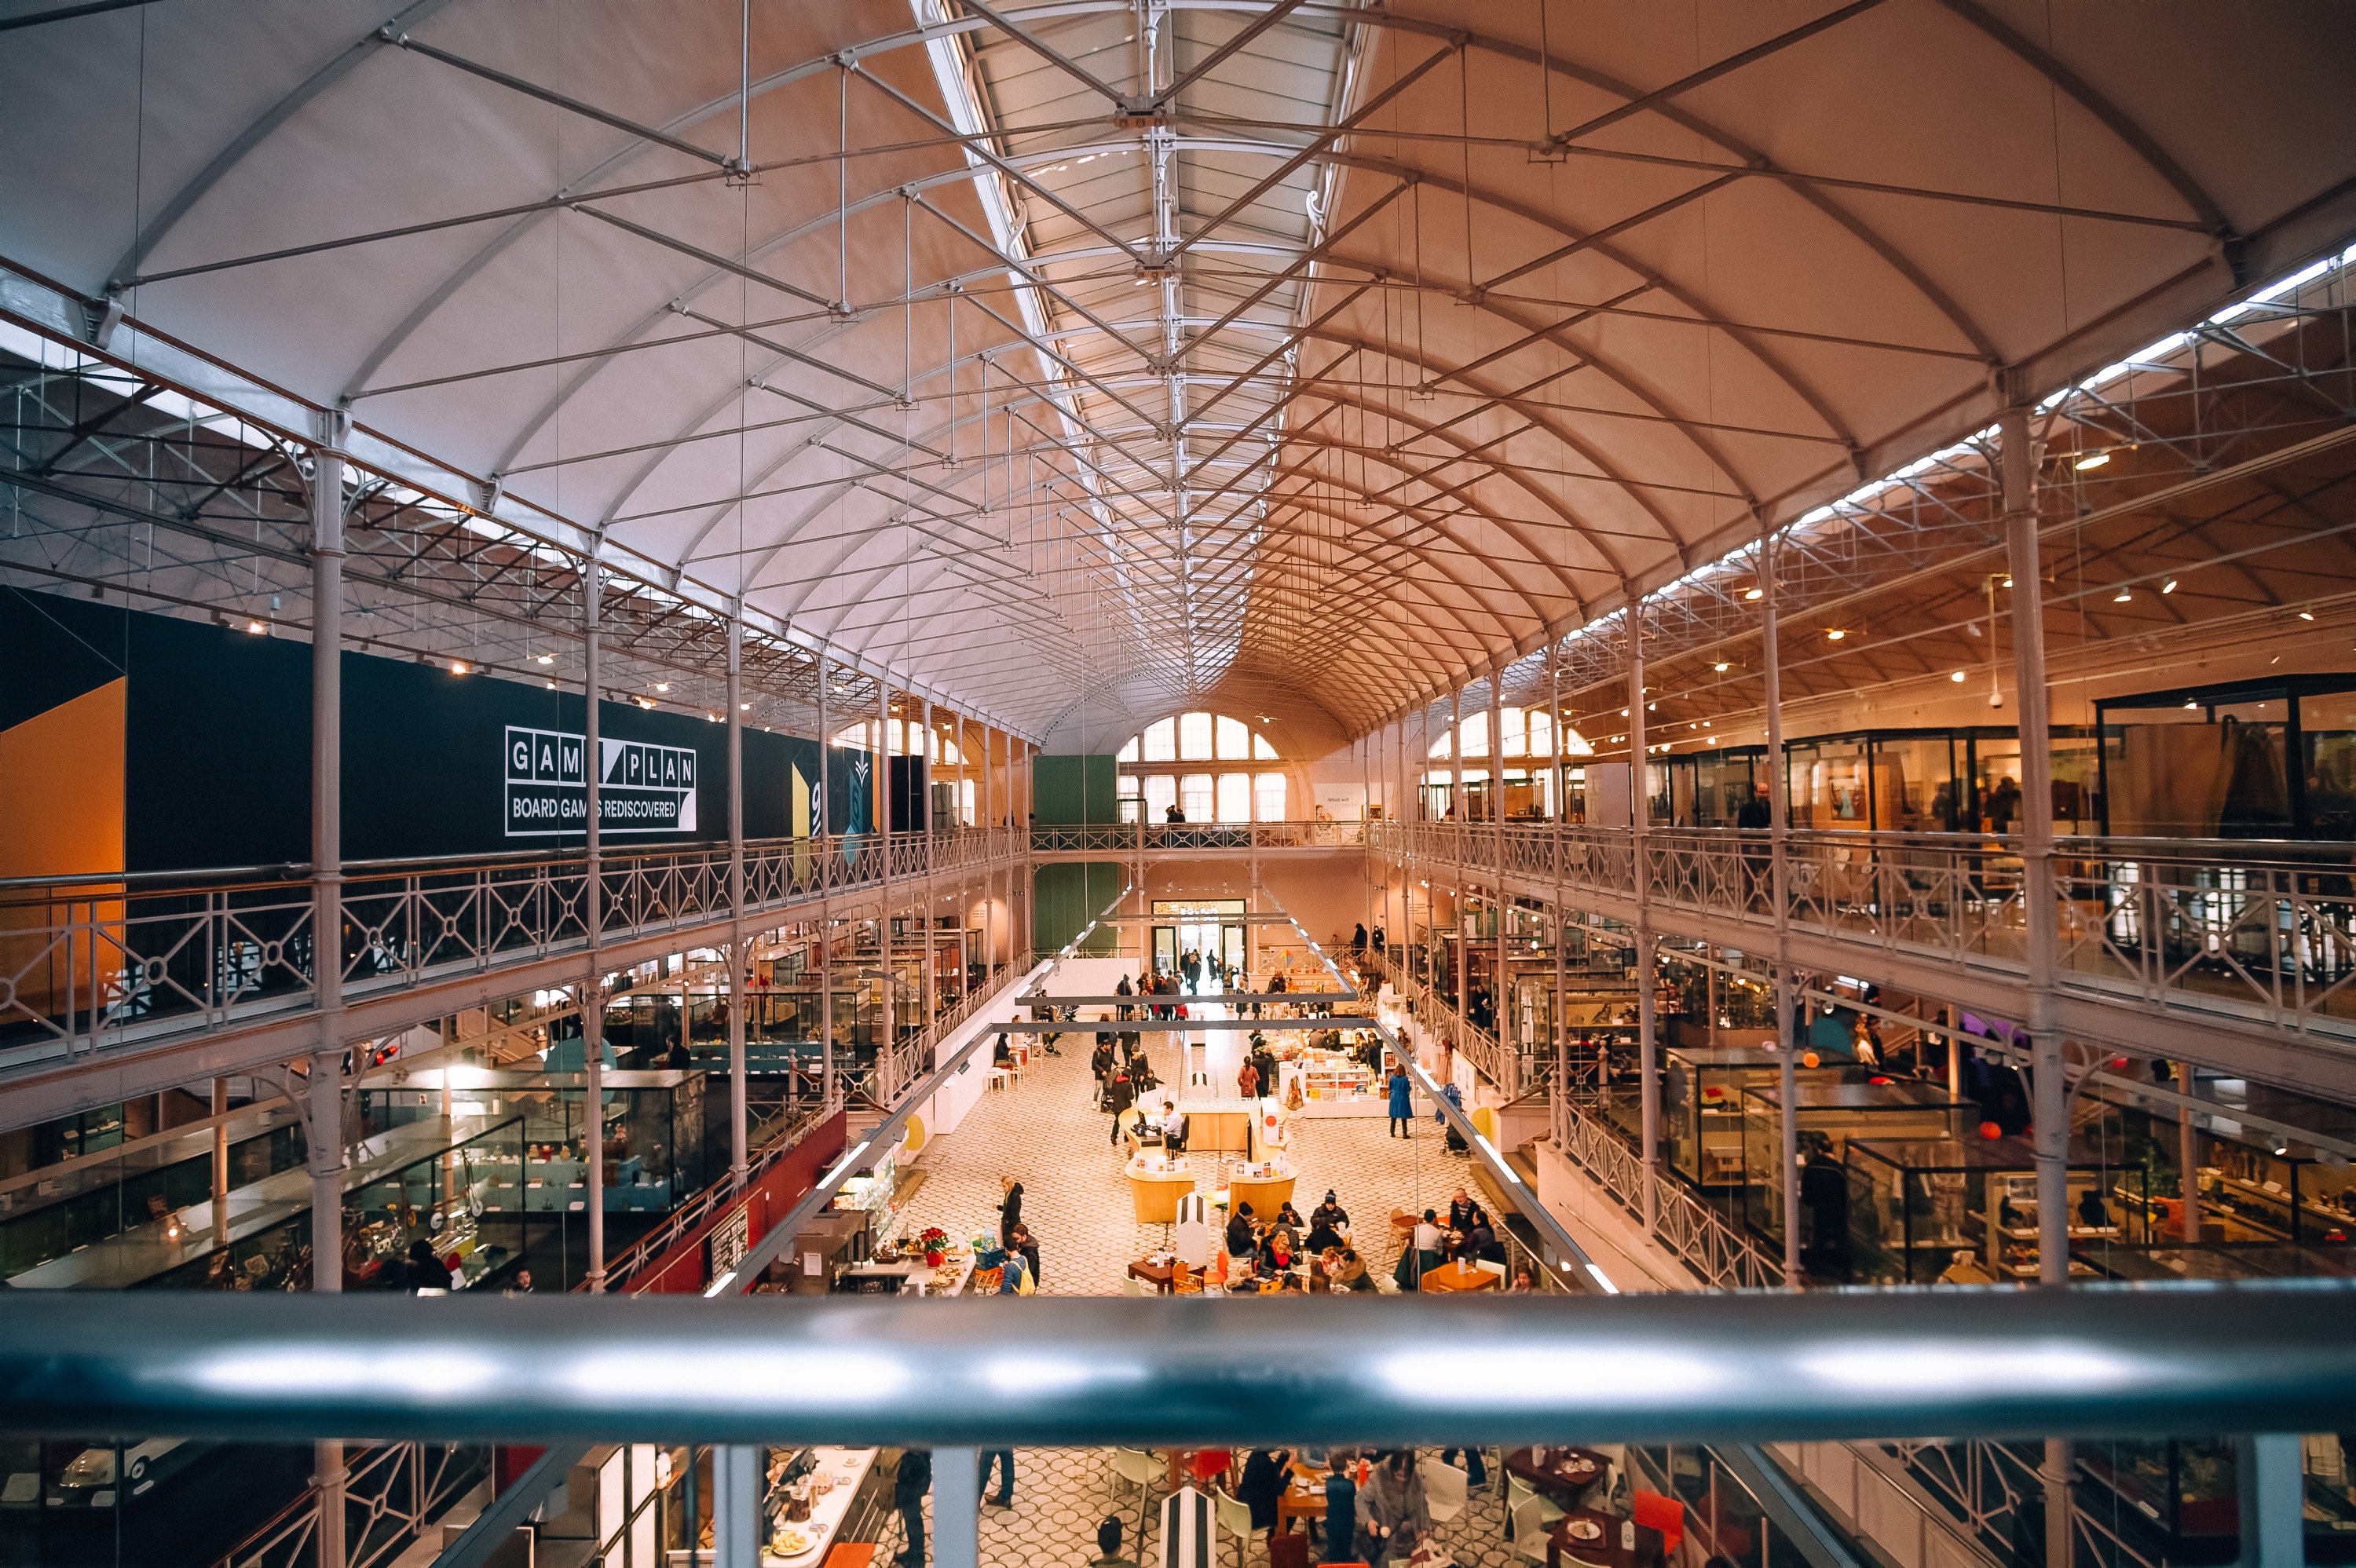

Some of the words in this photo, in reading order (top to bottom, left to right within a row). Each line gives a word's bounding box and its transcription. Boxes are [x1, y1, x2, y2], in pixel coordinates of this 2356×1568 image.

[513, 741, 579, 773] GAM
[631, 753, 691, 781] PLAN
[513, 797, 558, 818] BOARD
[561, 798, 602, 818] GAMS
[605, 799, 675, 818] REDISCOVERED
